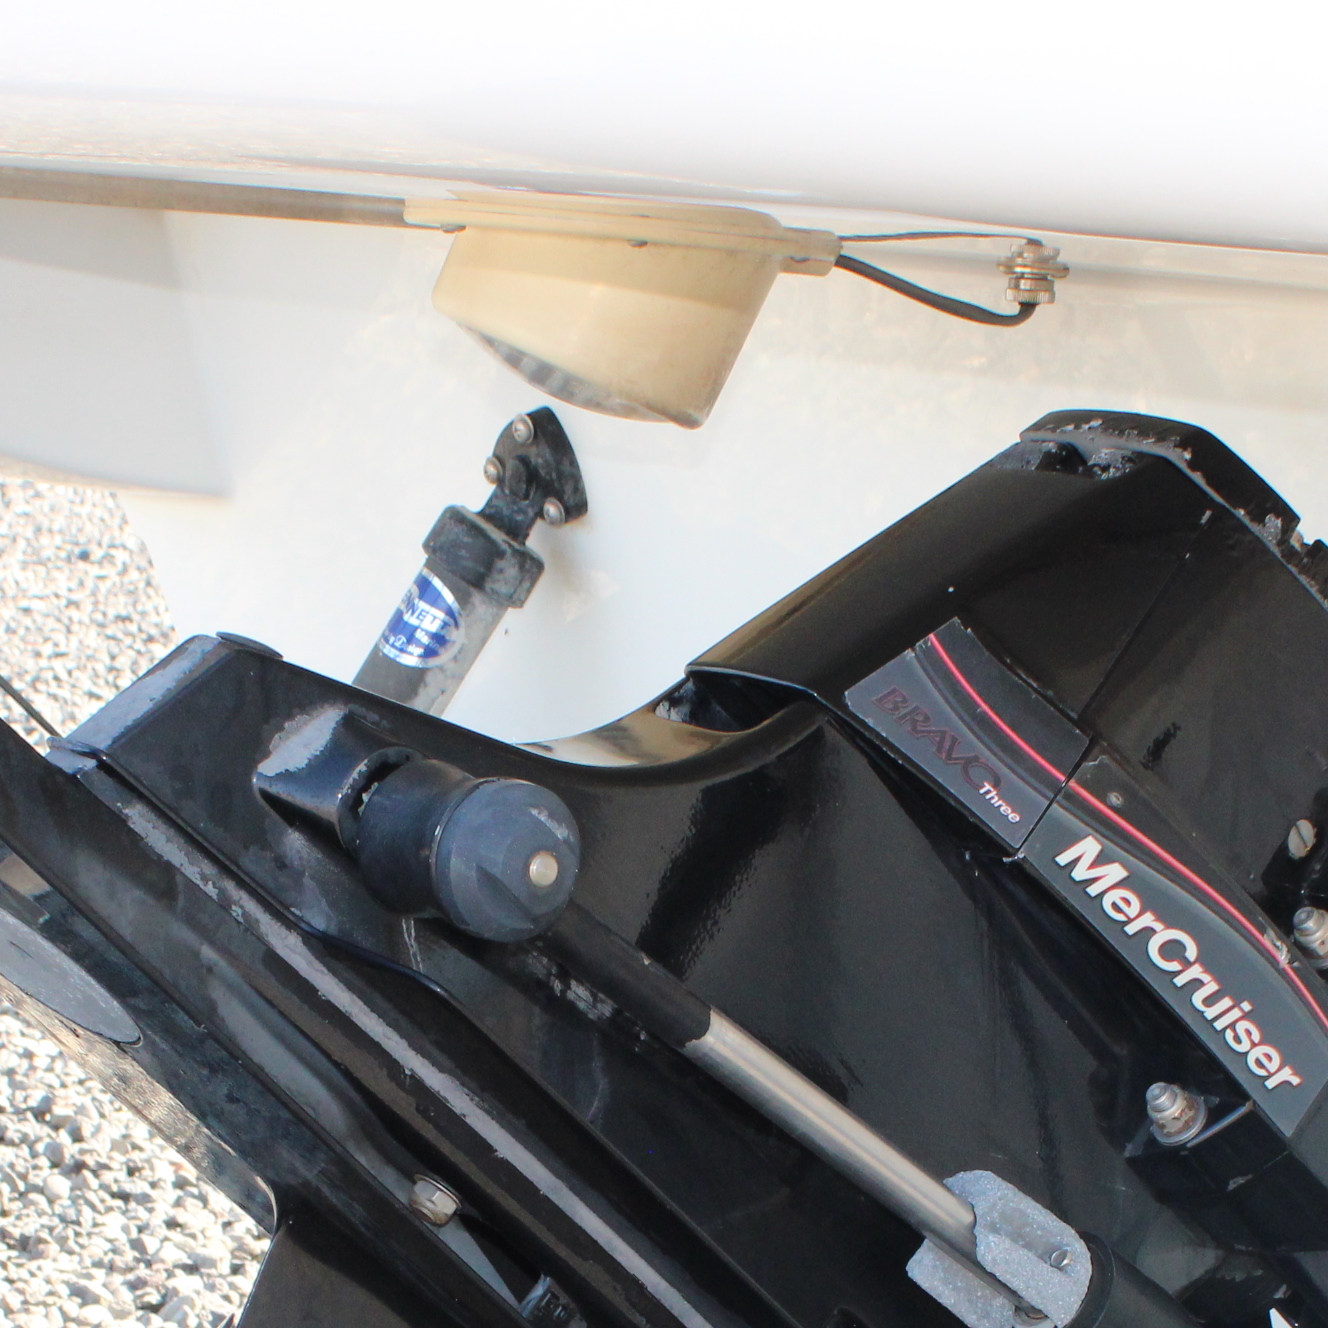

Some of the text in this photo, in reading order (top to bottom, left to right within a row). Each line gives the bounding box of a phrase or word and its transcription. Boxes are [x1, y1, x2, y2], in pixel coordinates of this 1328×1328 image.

[873, 686, 1002, 793] BRAVO
[978, 780, 1021, 824] Three
[1054, 835, 1302, 1092] MerCruiser
